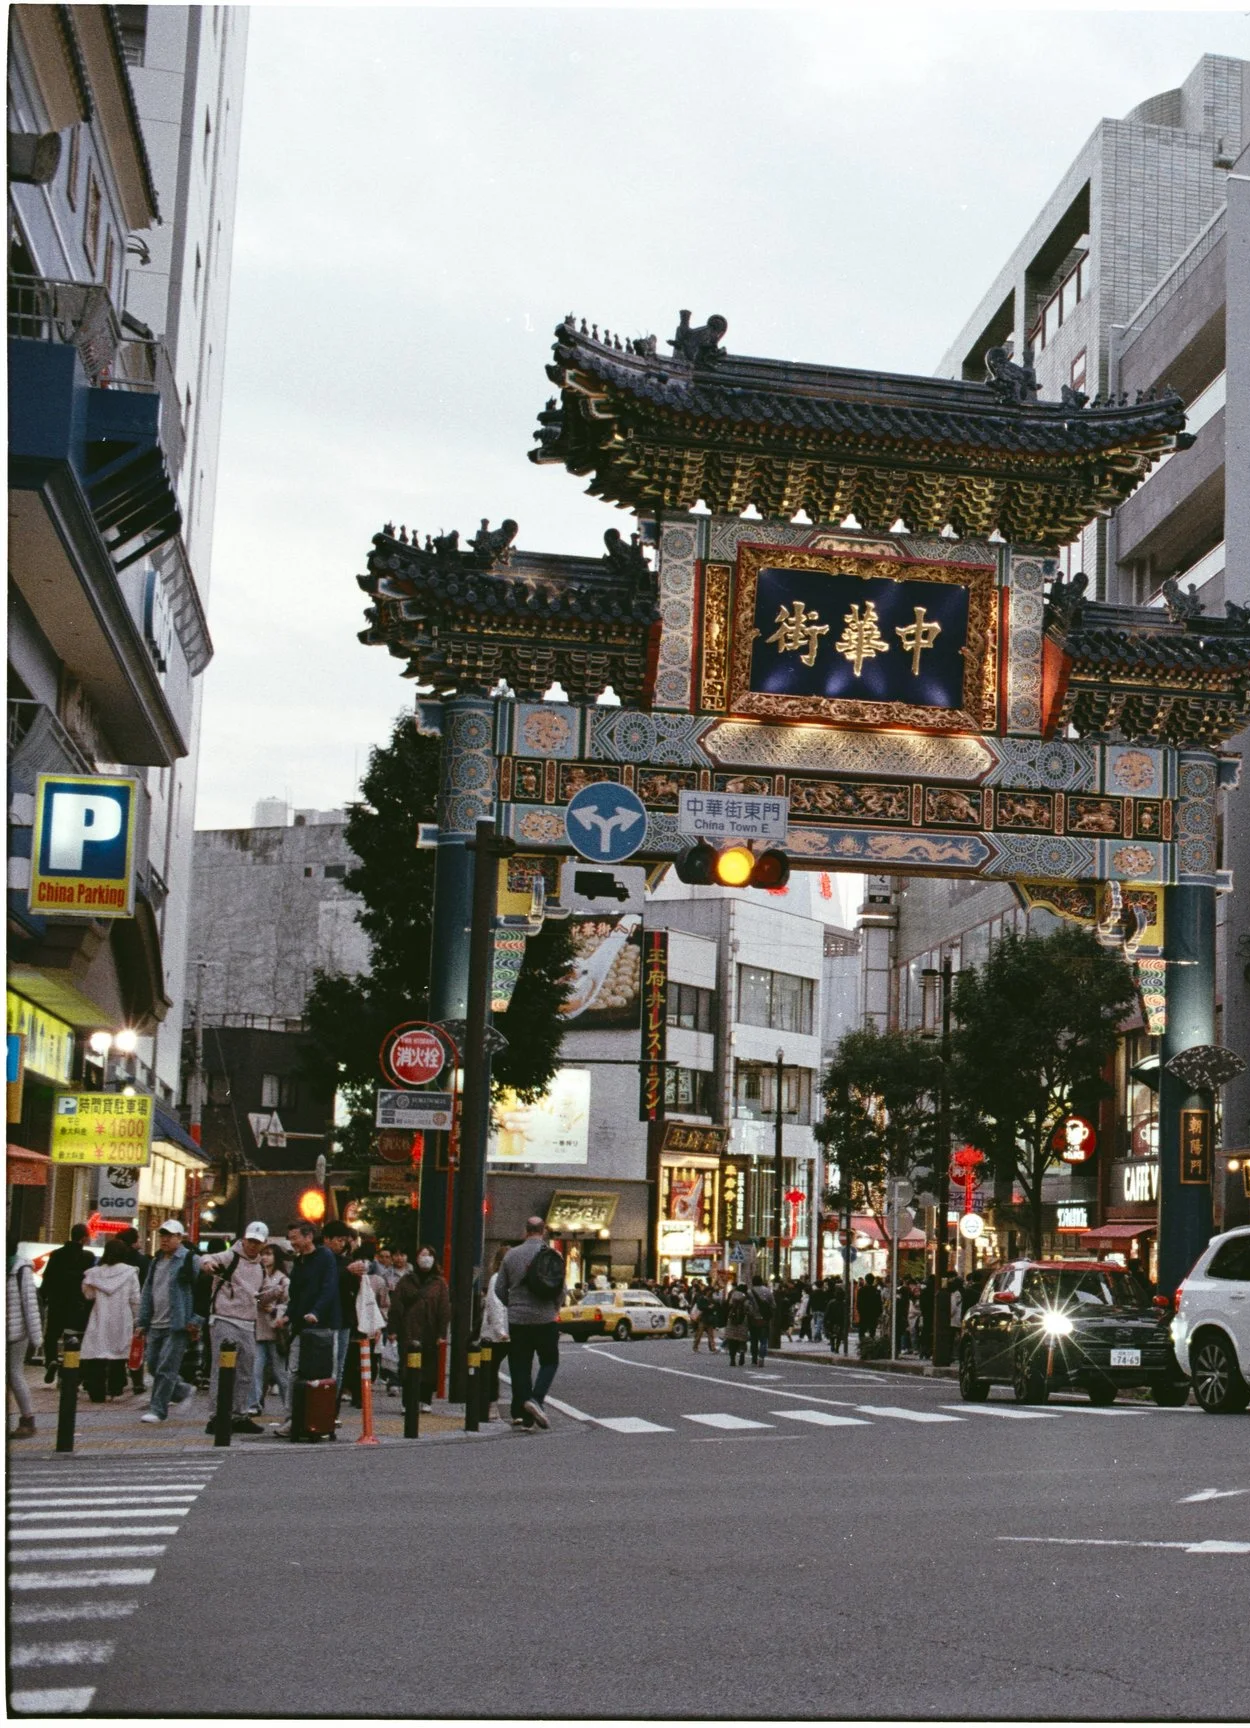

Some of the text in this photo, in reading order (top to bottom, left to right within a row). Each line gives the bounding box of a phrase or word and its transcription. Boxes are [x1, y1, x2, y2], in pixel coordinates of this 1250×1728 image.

[764, 600, 942, 676] 中華街
[686, 798, 780, 821] 中華街東門
[48, 792, 122, 870] P
[694, 819, 725, 831] China
[729, 821, 758, 833] Town
[38, 881, 125, 907] China Parking
[645, 949, 668, 1110] 王府井レストラン
[396, 1047, 439, 1068] 消火栓
[100, 1197, 137, 1208] GiGO
